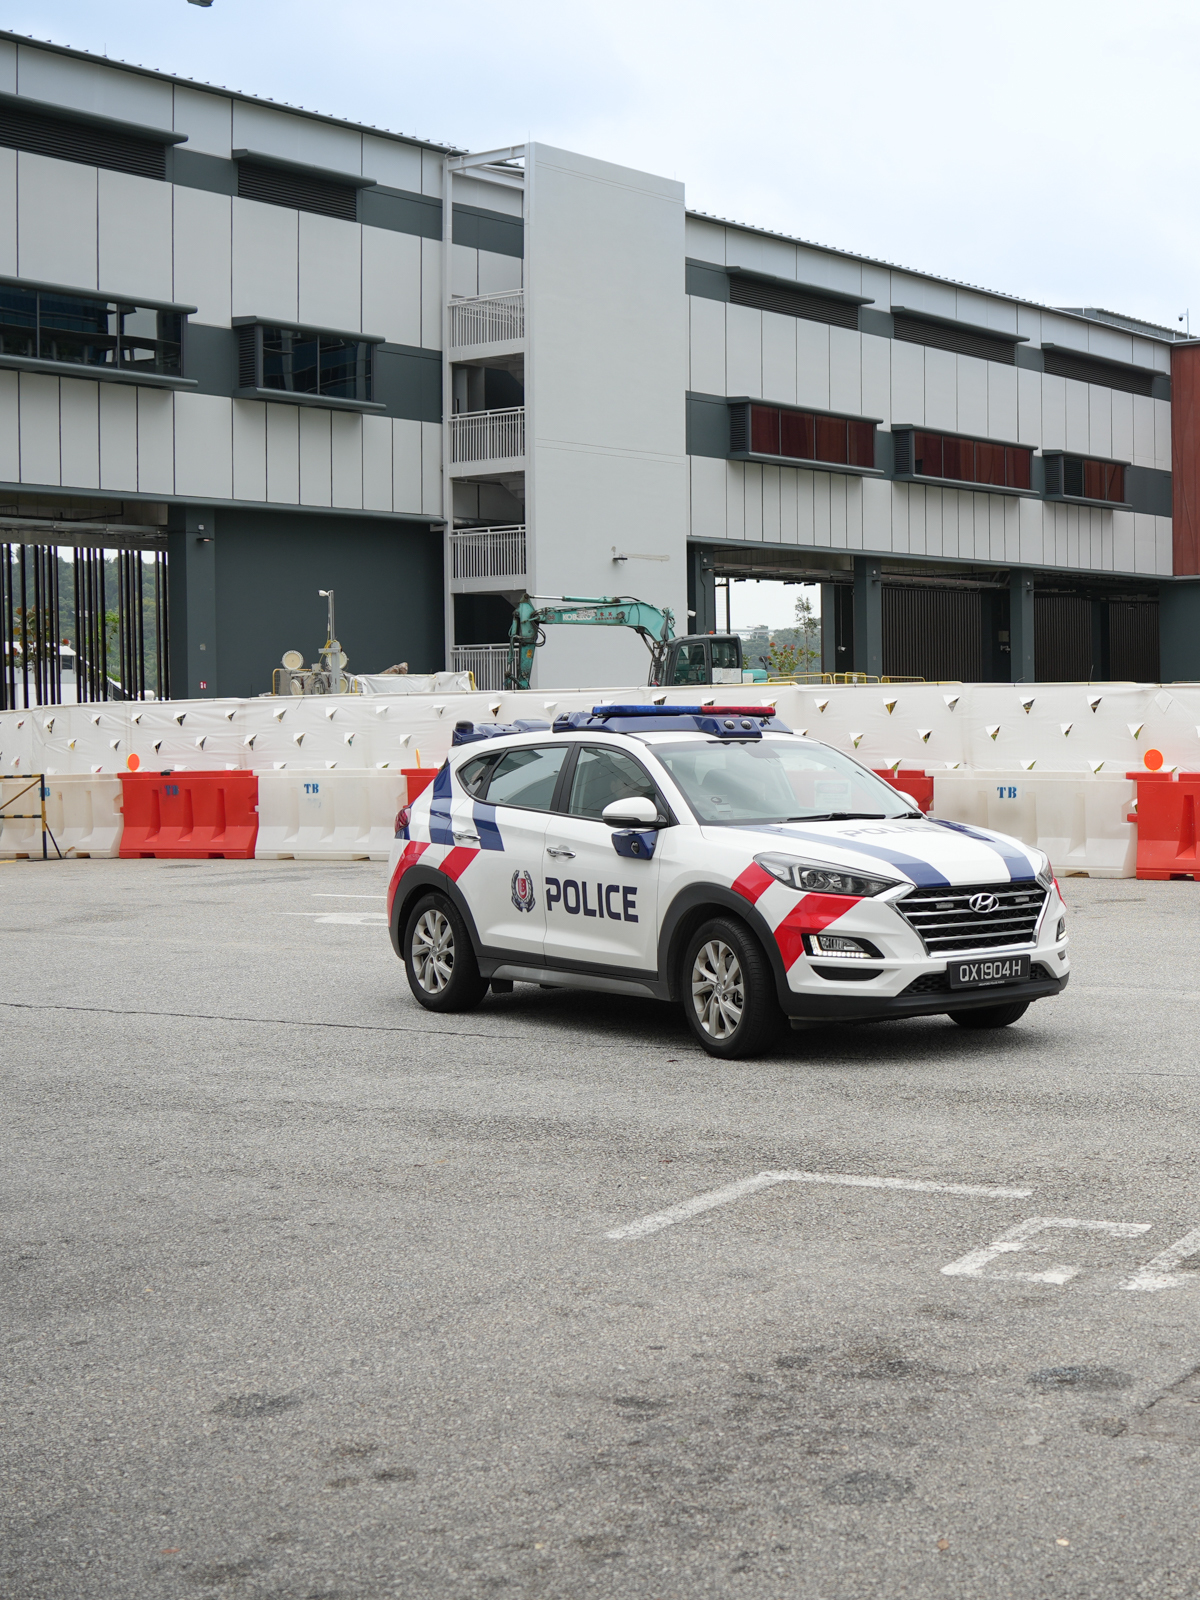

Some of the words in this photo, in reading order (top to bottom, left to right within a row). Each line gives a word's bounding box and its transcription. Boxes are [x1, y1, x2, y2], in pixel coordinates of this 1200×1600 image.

[164, 785, 179, 796] TB
[304, 783, 319, 794] TB
[997, 787, 1017, 799] TB
[545, 877, 639, 923] POLICE
[960, 960, 1021, 981] QX1904H
